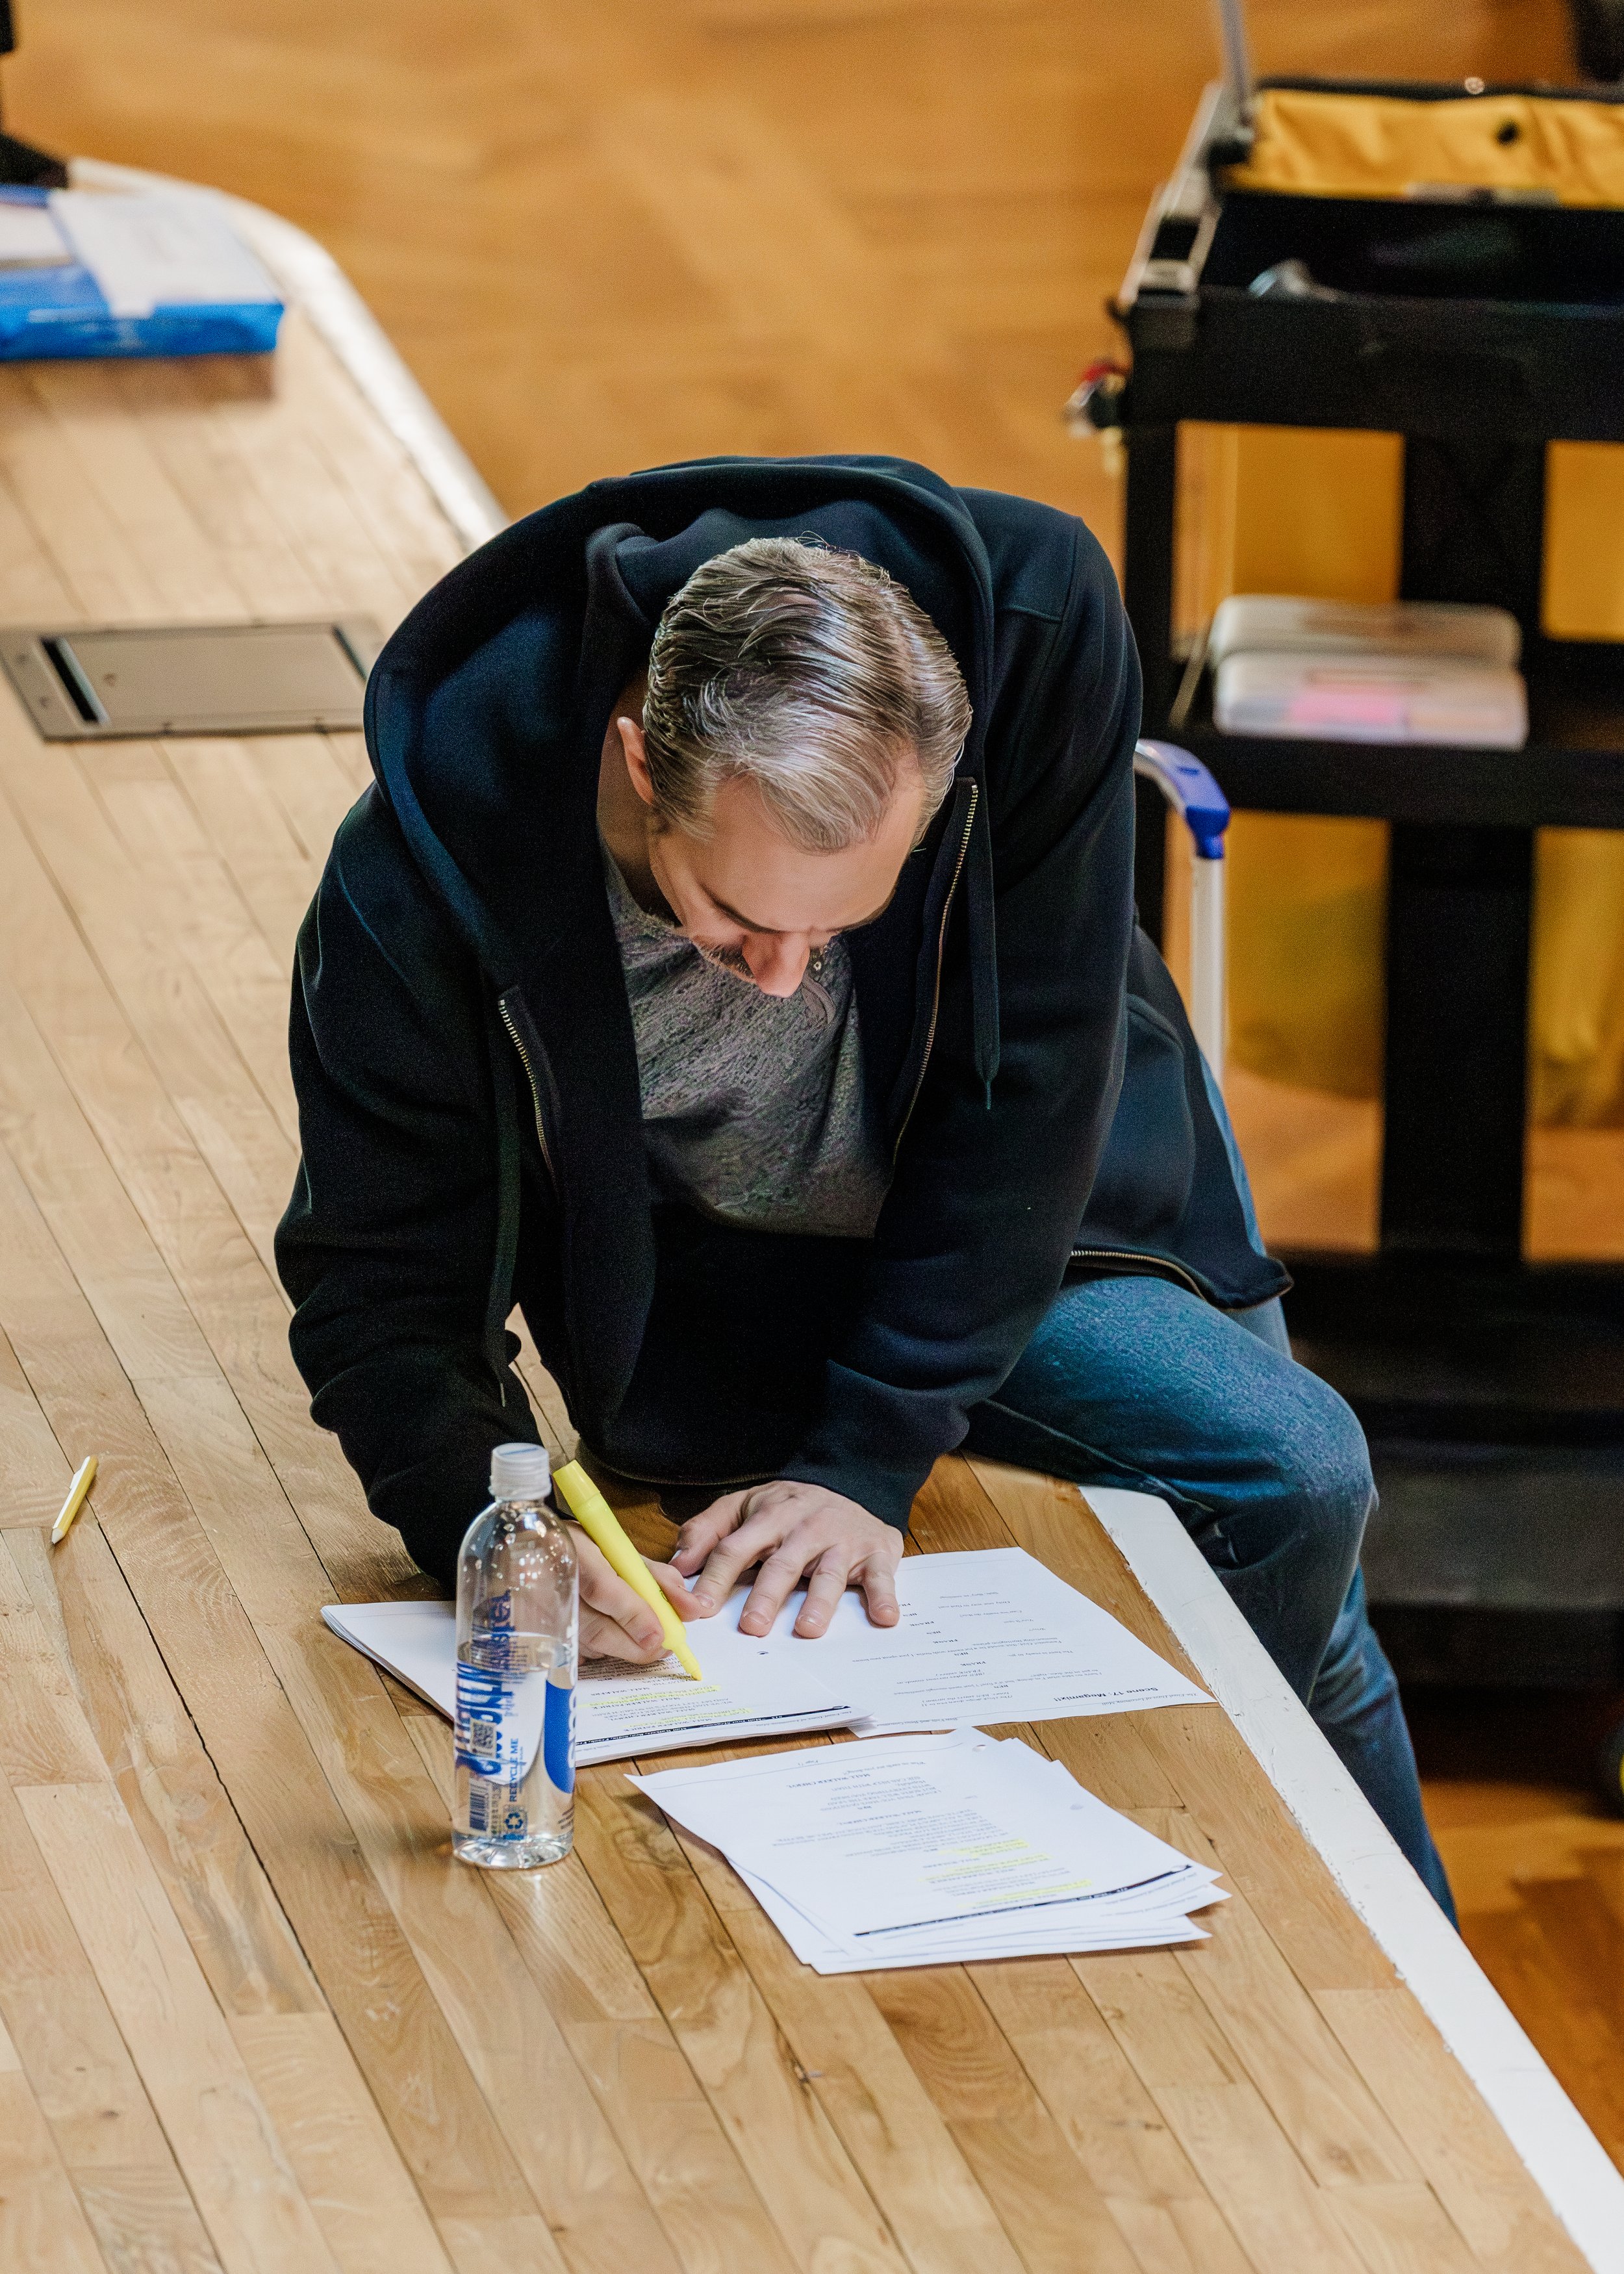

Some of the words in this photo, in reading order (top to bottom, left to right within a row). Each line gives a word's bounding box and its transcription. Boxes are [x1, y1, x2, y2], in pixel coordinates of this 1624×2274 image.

[1054, 1693, 1106, 1702] Megamix!!
[510, 1738, 518, 1752] ME
[509, 1756, 517, 1802] RECYCLE
